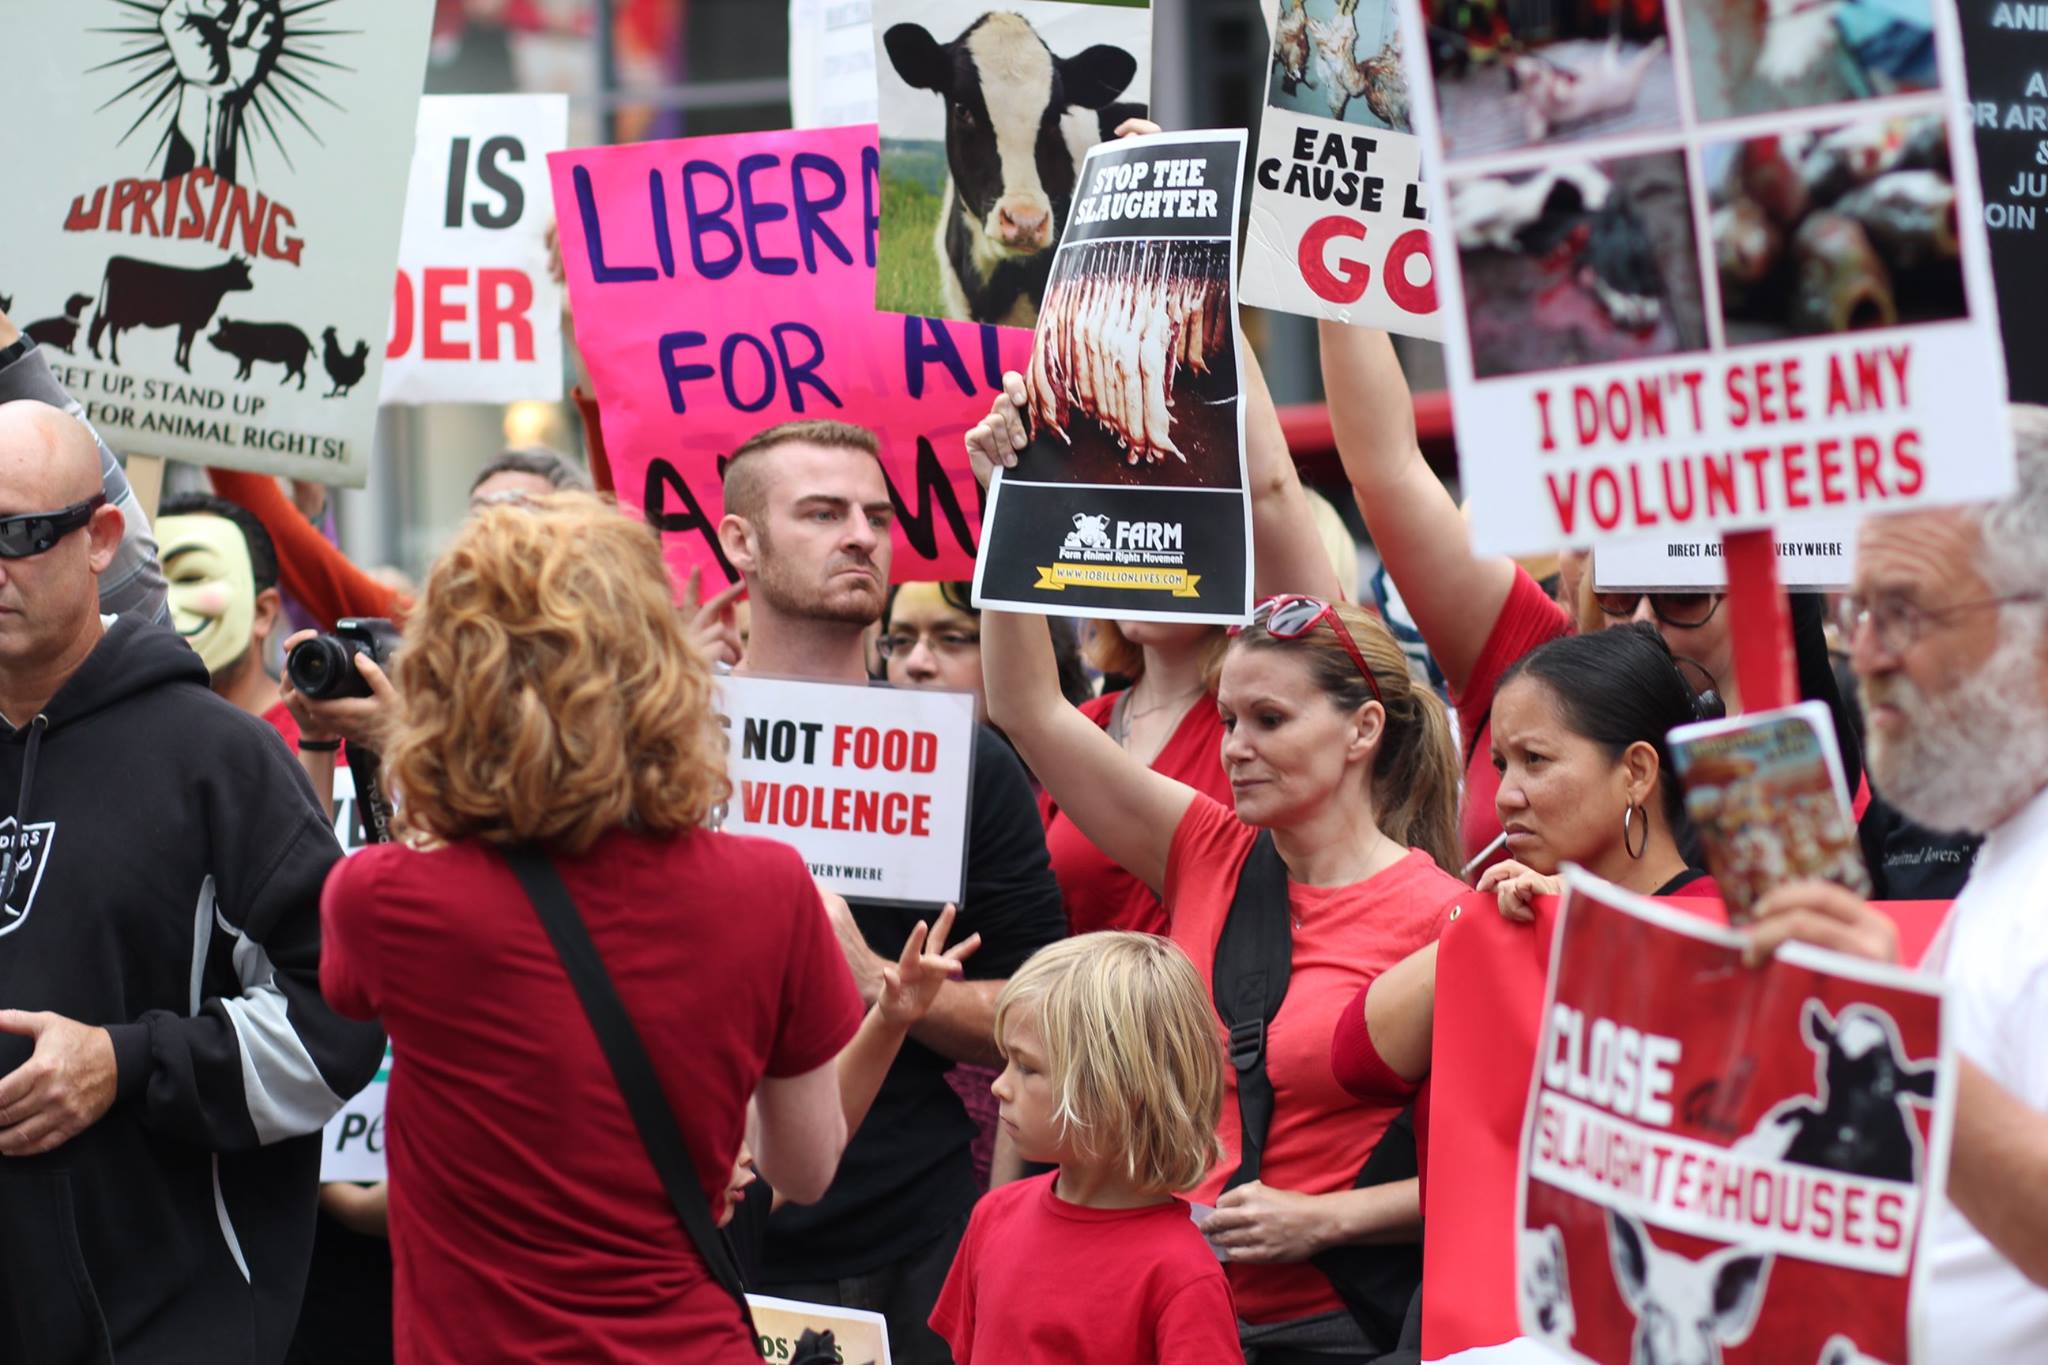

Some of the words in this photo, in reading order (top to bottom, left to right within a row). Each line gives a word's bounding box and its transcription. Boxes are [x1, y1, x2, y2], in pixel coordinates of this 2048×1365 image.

[1992, 3, 2048, 31] ANI
[1092, 162, 1149, 194] STOP
[1153, 158, 1207, 188] THE
[1293, 127, 1377, 172] EAT
[445, 135, 526, 230] IS
[1075, 189, 1218, 225] SLAUGHTER
[1258, 158, 1384, 213] CAUSE
[1403, 184, 1432, 223] L
[63, 165, 305, 267] UPRISING
[102, 373, 136, 400] UP,
[143, 379, 224, 410] STAND
[233, 396, 266, 416] UP
[658, 322, 843, 415] FOR
[1536, 392, 1557, 452] I
[1573, 371, 1704, 447] DON'T
[1726, 358, 1807, 428] SEE
[1828, 343, 1912, 417] ANY
[86, 400, 135, 428] FOR
[140, 411, 237, 446] ANIMAL
[242, 426, 346, 462] RIGHTS!
[1547, 432, 1924, 535] VOLUNTEERS
[1059, 549, 1082, 561] Farm
[1115, 553, 1140, 565] Rights
[1116, 521, 1182, 551] FARM
[1667, 543, 1700, 557] DIRECT
[742, 717, 823, 765] NOT
[832, 724, 938, 774] FOOD
[741, 780, 932, 837] VIOLENCE
[0, 830, 41, 849] DIRS
[1543, 1002, 1682, 1127] CLOSE
[1539, 1102, 1908, 1252] SLAUGHTERHOUSES
